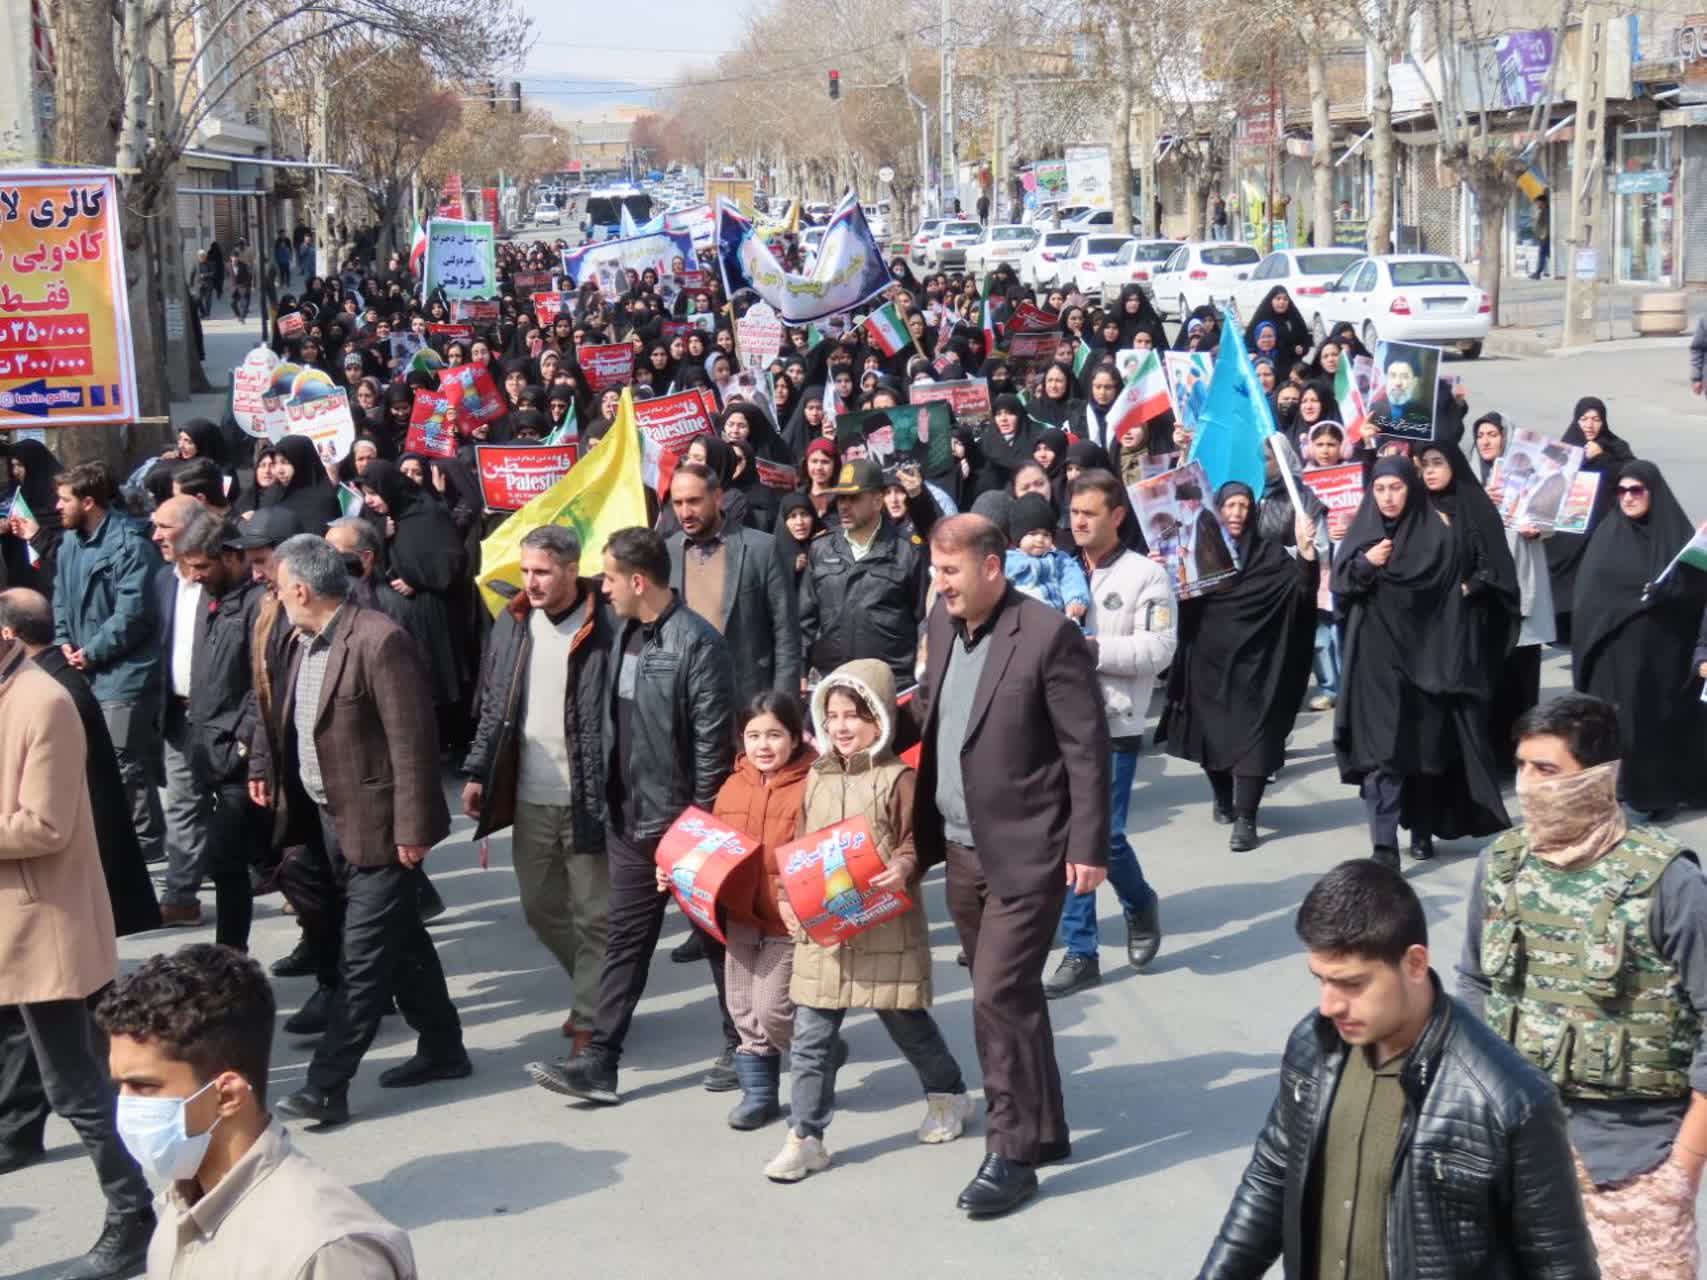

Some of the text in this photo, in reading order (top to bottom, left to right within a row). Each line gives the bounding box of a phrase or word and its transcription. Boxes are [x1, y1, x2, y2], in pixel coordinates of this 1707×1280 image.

[13, 231, 103, 273] کادویی
[0, 280, 70, 313] فقط
[482, 453, 571, 479] فلسطین
